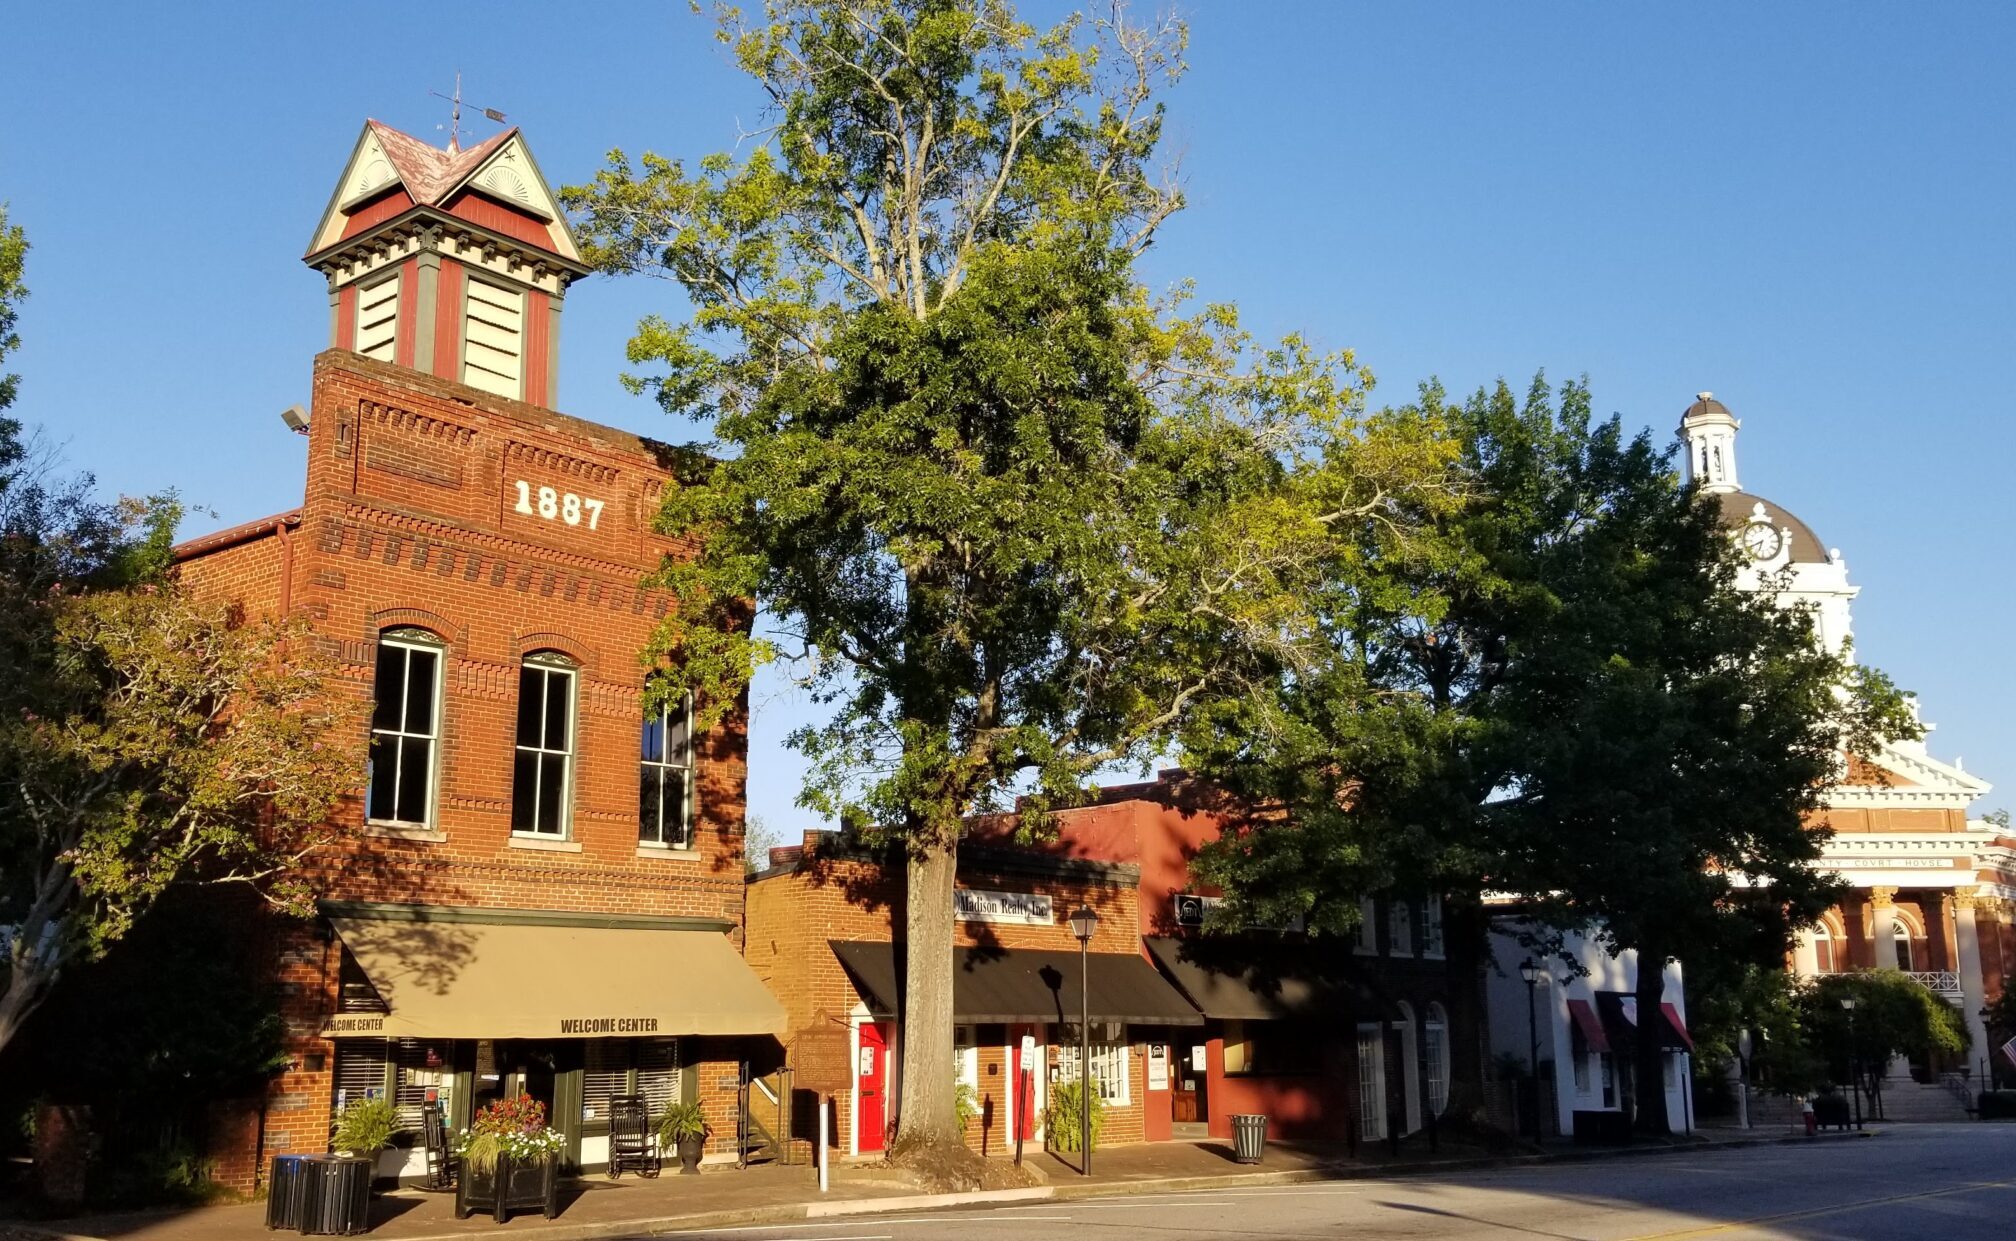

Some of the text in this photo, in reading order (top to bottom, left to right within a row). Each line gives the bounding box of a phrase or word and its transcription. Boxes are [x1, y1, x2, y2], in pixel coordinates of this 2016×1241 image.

[515, 480, 605, 530] 1887
[960, 896, 997, 914] Madison
[323, 1019, 384, 1031] WELCOME CENTER
[561, 1018, 658, 1033] WELCOME CENTER
